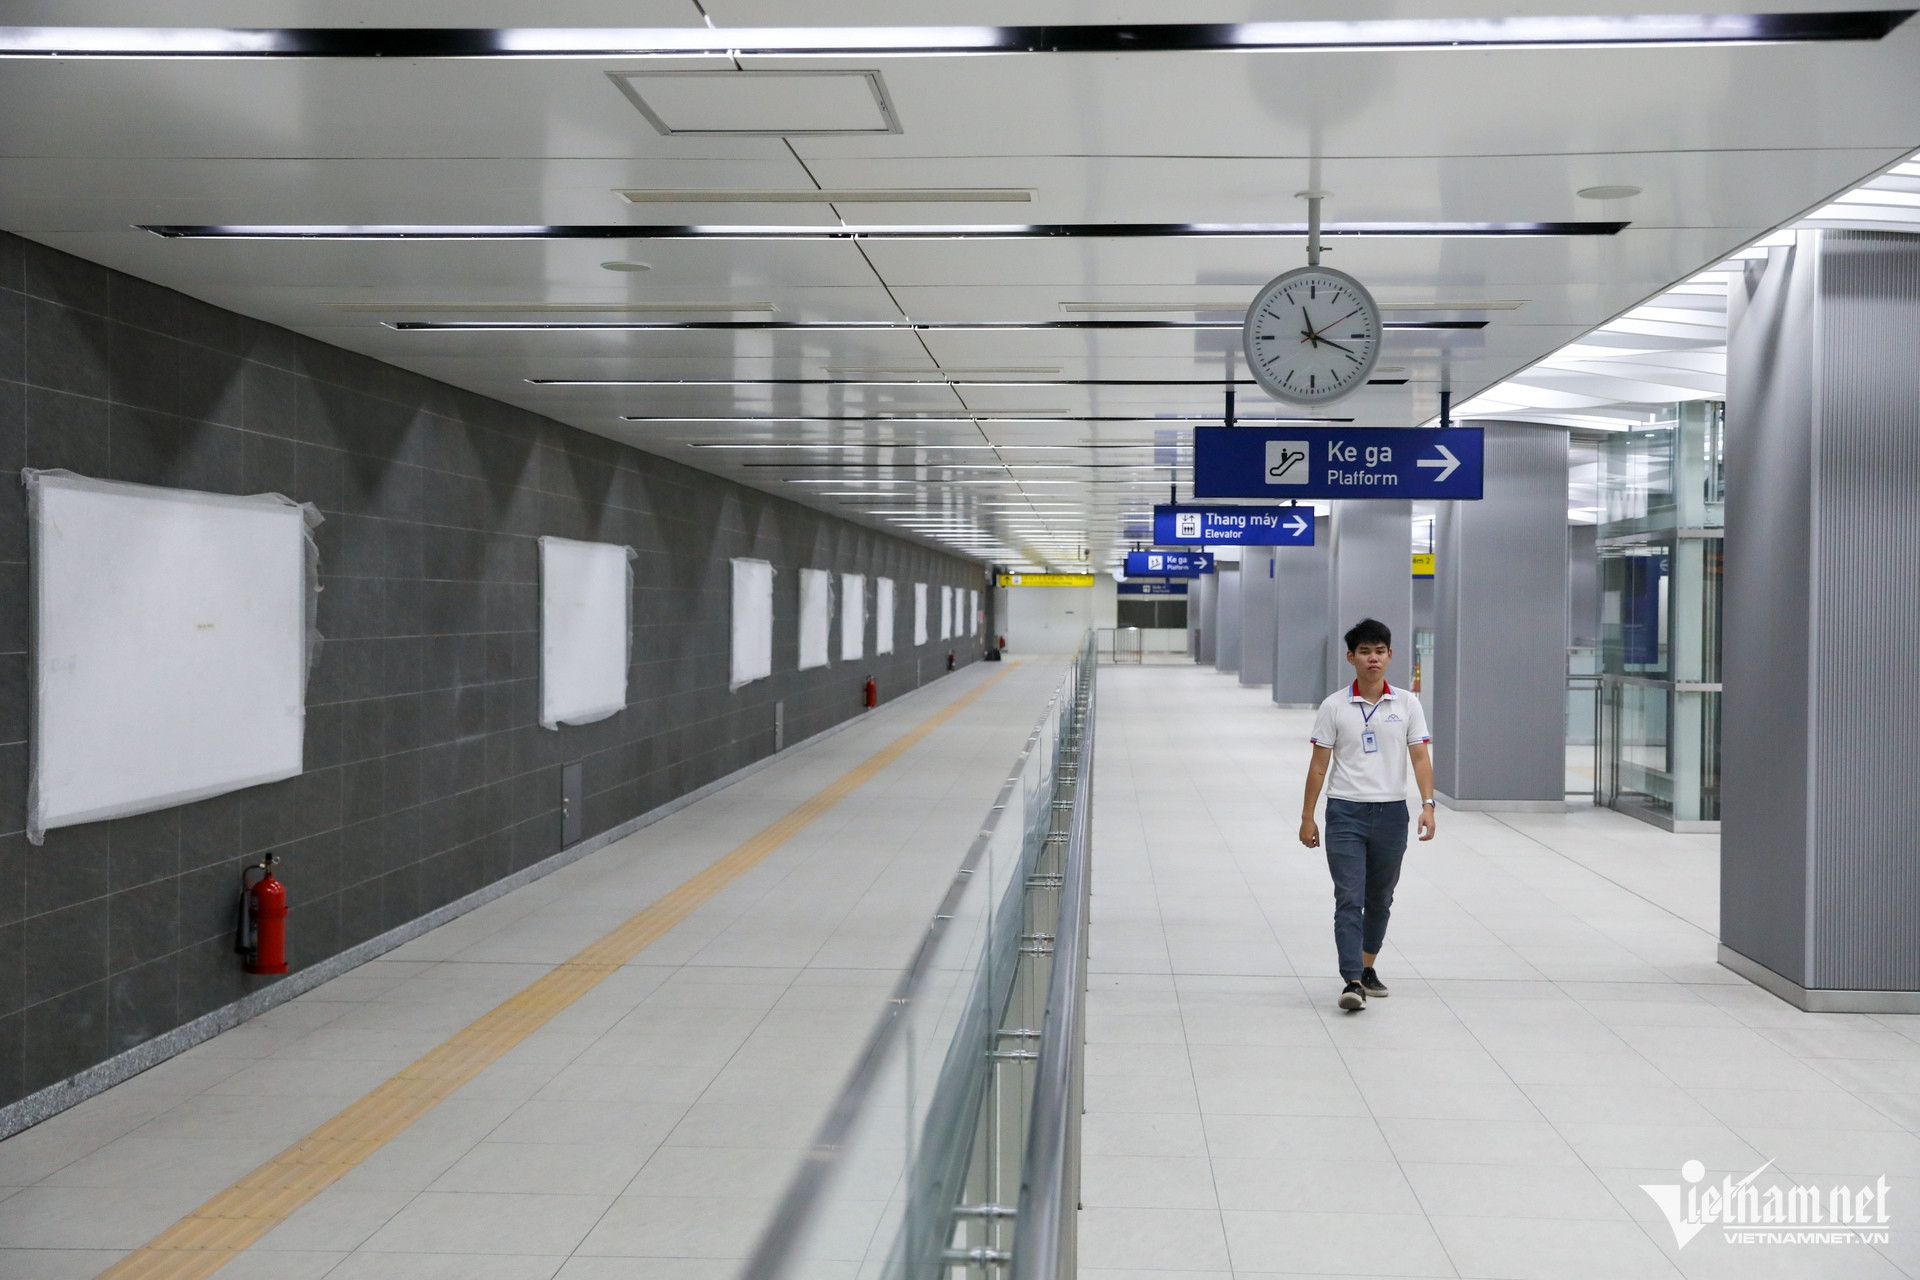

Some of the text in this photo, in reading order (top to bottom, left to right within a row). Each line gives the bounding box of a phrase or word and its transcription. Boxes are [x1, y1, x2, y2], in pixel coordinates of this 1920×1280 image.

[1328, 440, 1392, 468] Ke ga
[1327, 469, 1398, 486] Platform
[1205, 512, 1278, 529] Thang máy
[1205, 528, 1243, 539] Elevator
[1166, 555, 1188, 565] Ke ga
[1425, 556, 1431, 565] 2
